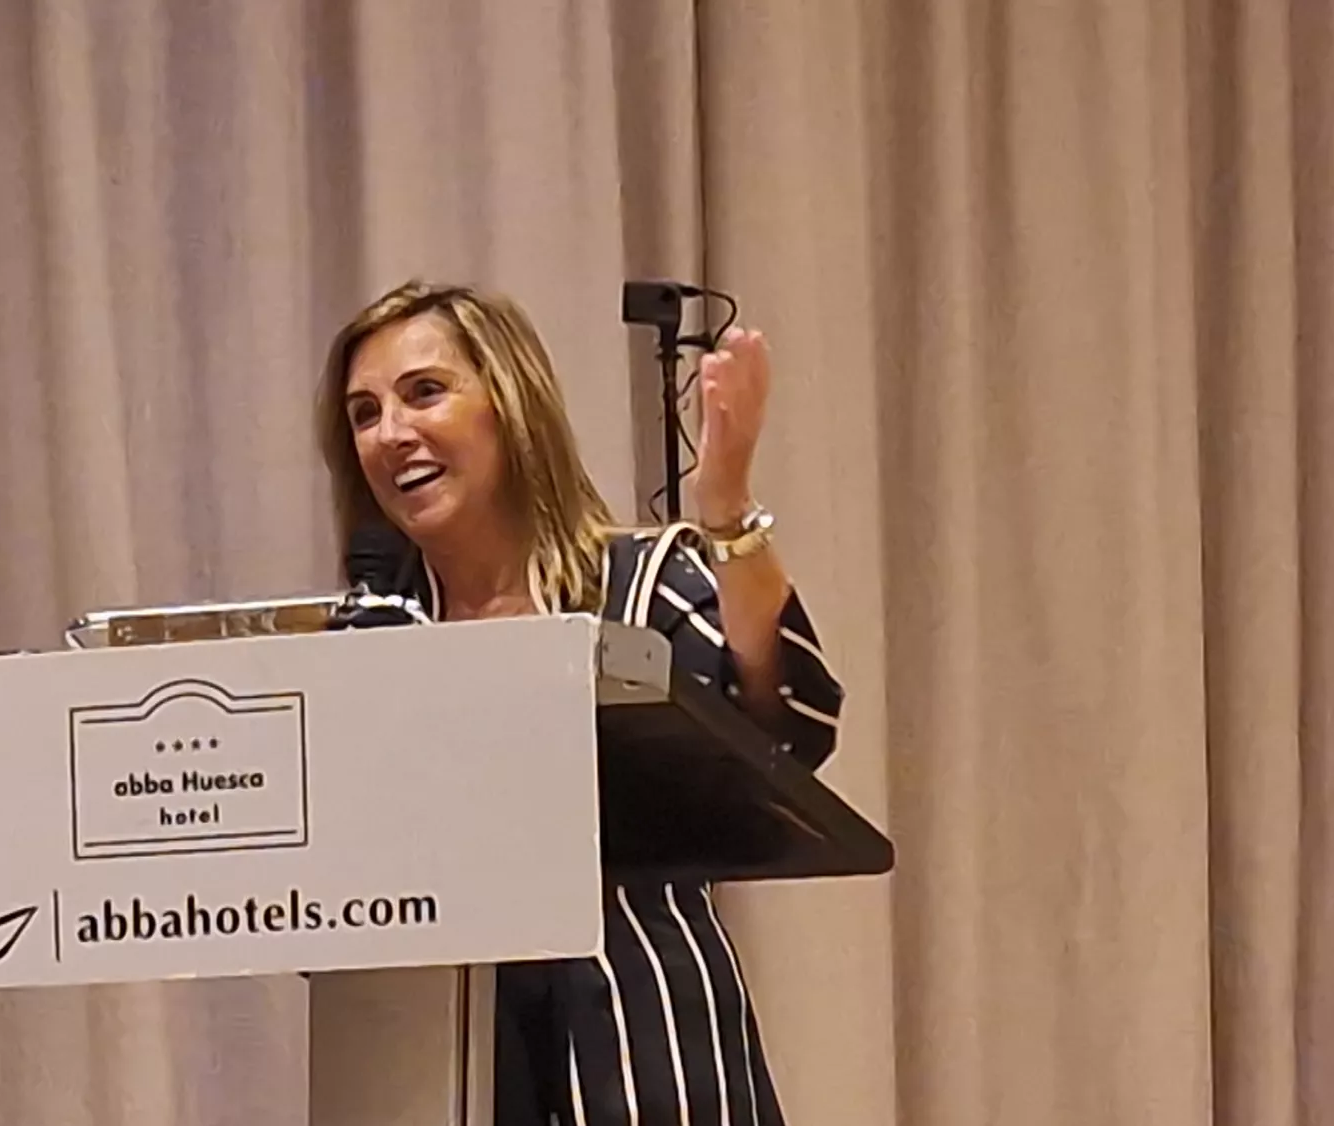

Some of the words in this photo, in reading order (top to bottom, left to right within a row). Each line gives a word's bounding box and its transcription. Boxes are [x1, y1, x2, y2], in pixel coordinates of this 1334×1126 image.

[114, 772, 174, 797] abba
[182, 770, 264, 792] Huesca
[160, 803, 220, 826] hotel
[77, 889, 437, 943] abbahotels.com
